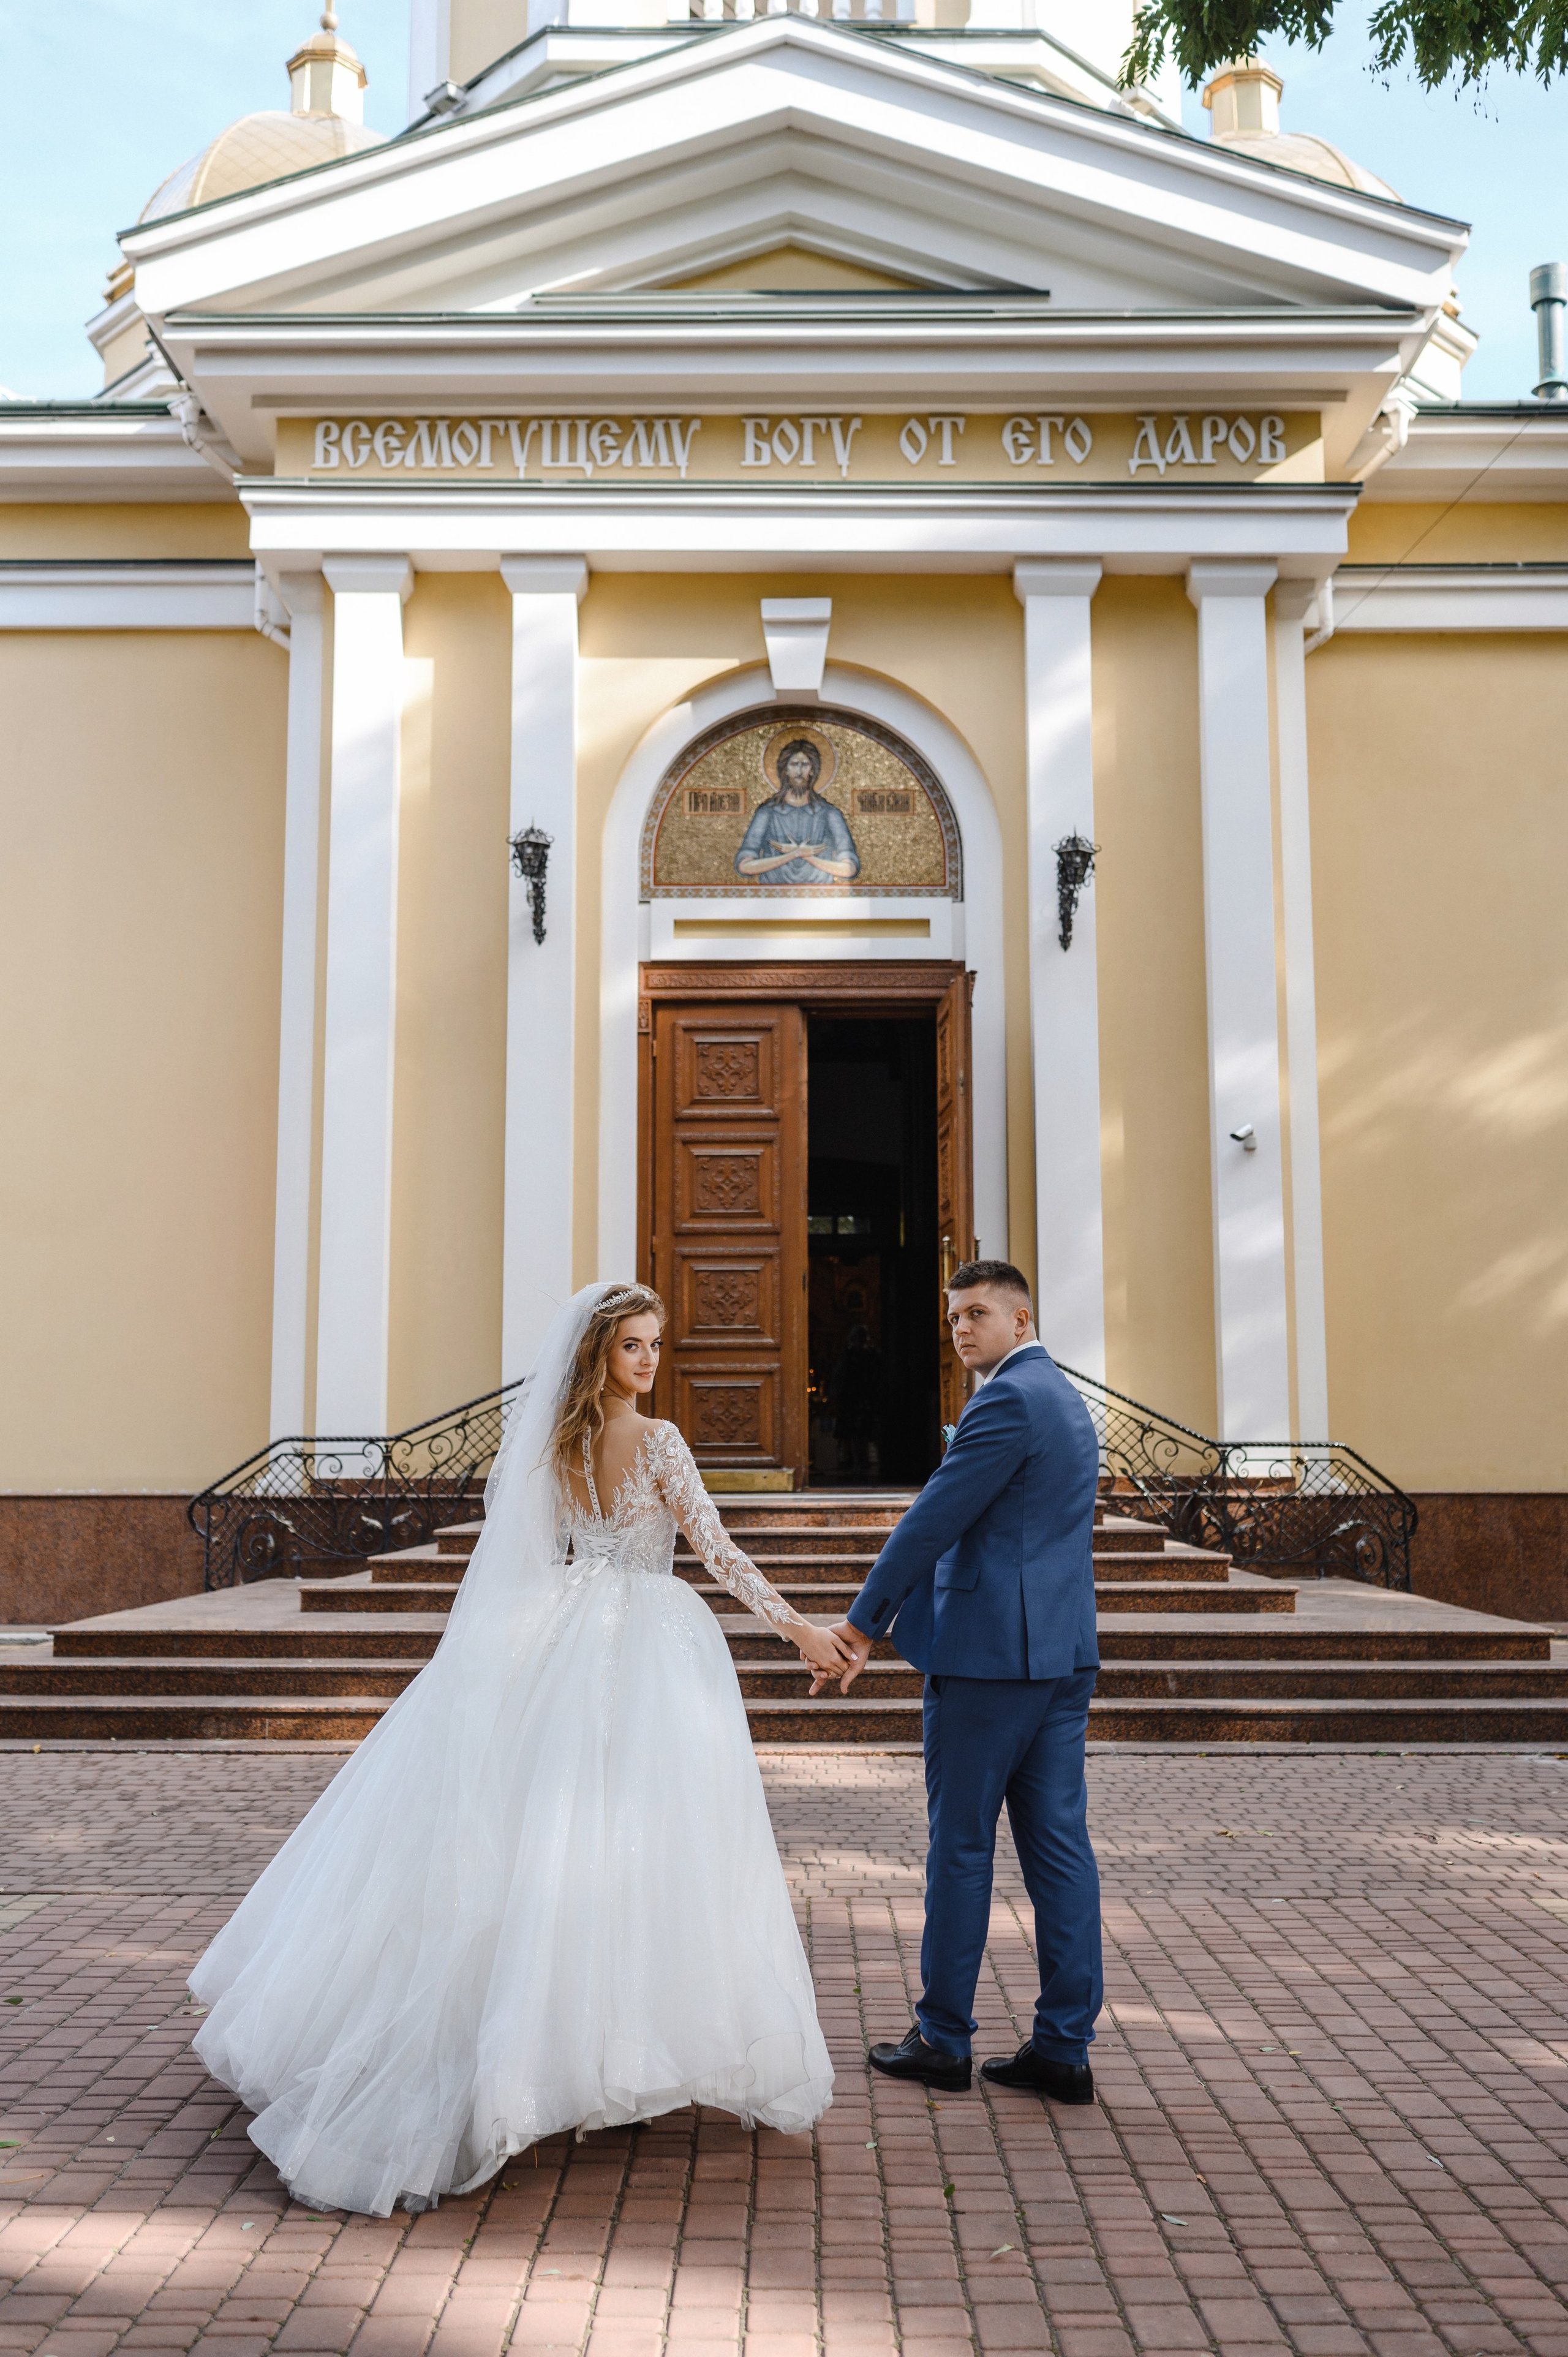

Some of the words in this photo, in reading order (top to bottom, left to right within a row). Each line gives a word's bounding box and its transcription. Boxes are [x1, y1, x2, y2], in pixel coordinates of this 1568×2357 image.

[739, 418, 862, 478] БОГУ
[899, 417, 967, 466] ОТ
[1001, 417, 1093, 466] ЕГО
[1128, 416, 1287, 476] ДАРОВ
